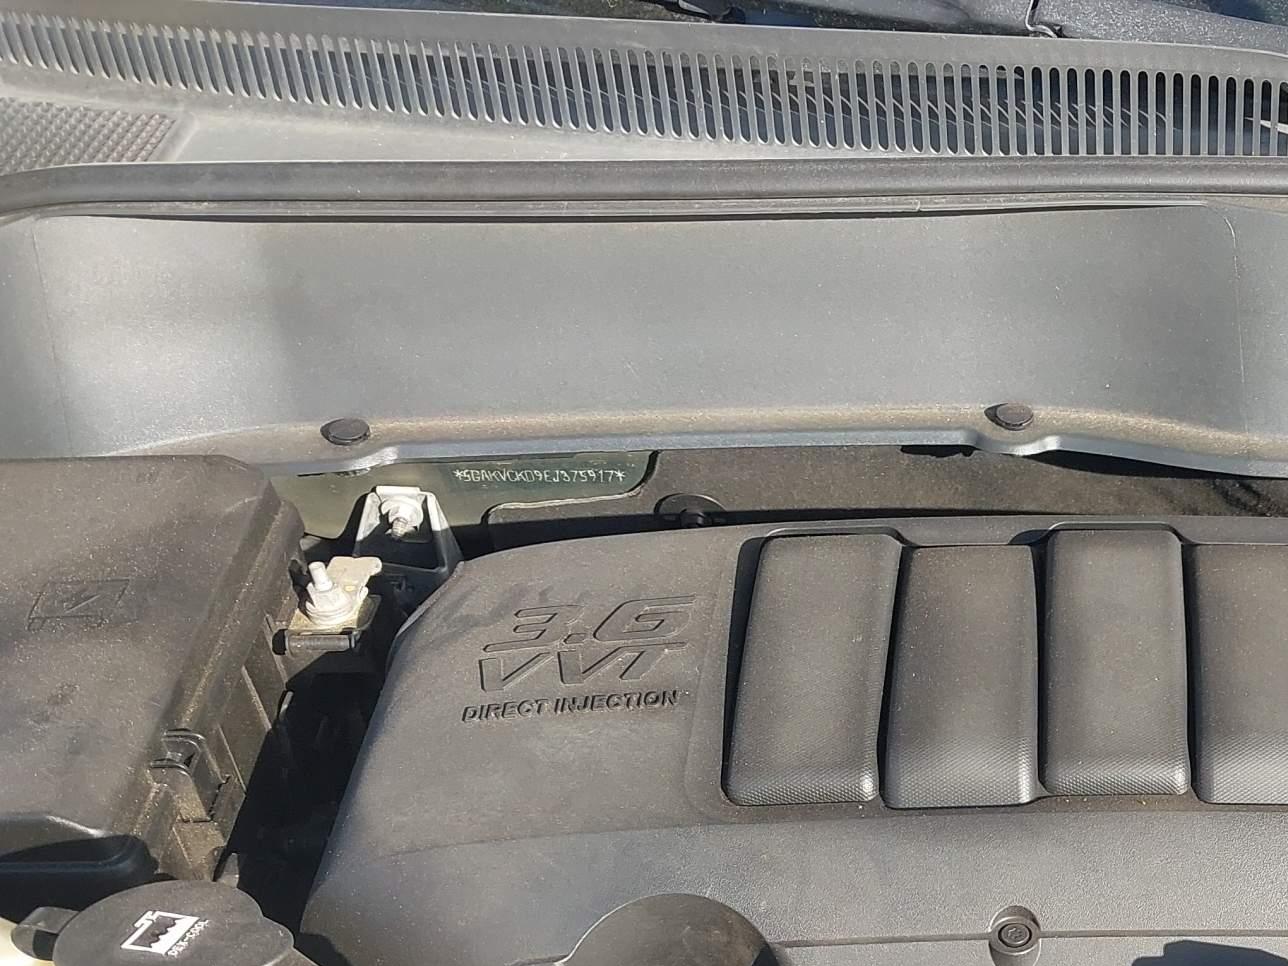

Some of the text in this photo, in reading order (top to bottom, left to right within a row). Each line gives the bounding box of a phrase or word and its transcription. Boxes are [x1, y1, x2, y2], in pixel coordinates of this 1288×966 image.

[482, 594, 697, 653] 3.6
[478, 641, 690, 692] VVT
[461, 690, 677, 722] DIRECT INJECTION
